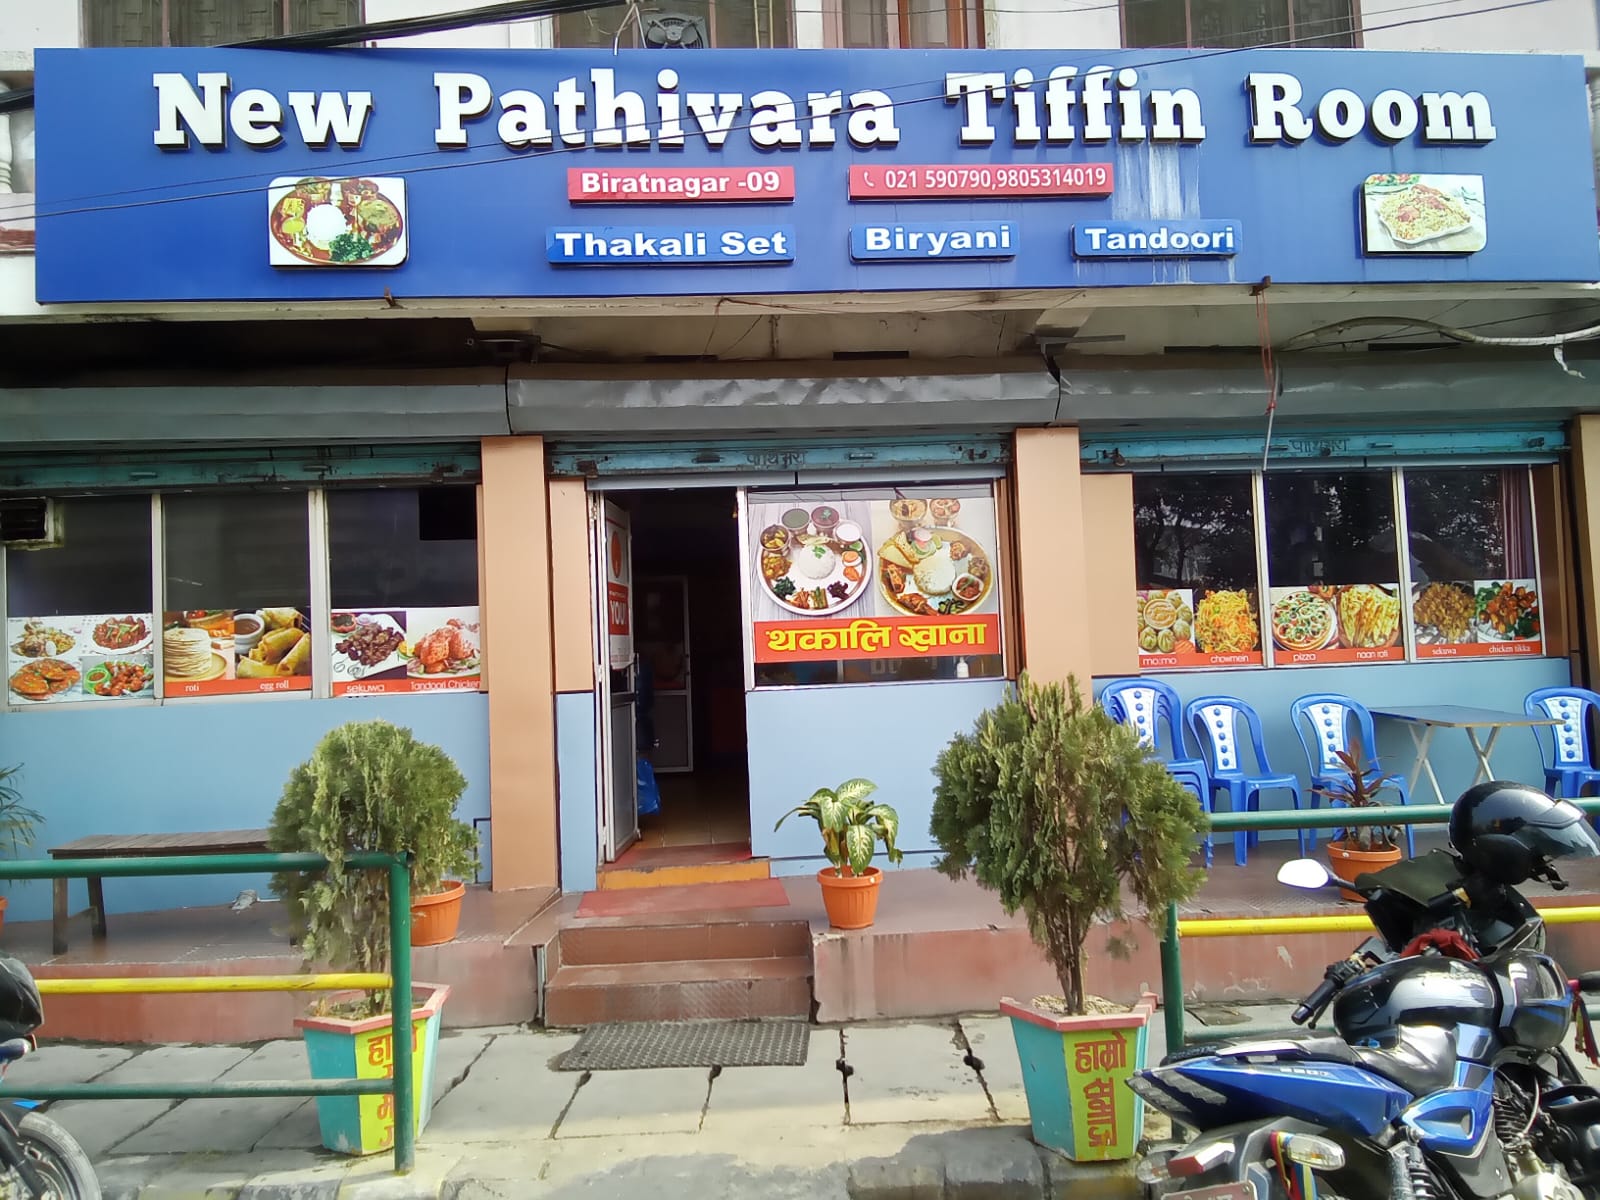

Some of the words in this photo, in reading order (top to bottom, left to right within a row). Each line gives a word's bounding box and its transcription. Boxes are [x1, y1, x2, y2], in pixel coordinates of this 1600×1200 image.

[153, 72, 373, 147] New
[433, 69, 899, 148] Pathivara
[945, 65, 1206, 143] Tiffin
[1246, 72, 1497, 143] Room
[580, 172, 732, 197] Biratnagar
[736, 171, 781, 192] -09
[884, 170, 918, 189] 021
[925, 167, 1107, 190] 590790,9805314019
[555, 231, 708, 258] Thakali
[721, 230, 788, 257] Set
[865, 225, 1012, 255] Biryani
[1085, 226, 1235, 250] Tandoori
[898, 623, 988, 652] खाना
[185, 684, 200, 692] roti
[260, 682, 274, 692] egg
[275, 680, 290, 689] roll
[1074, 1030, 1128, 1074] हाम्रो
